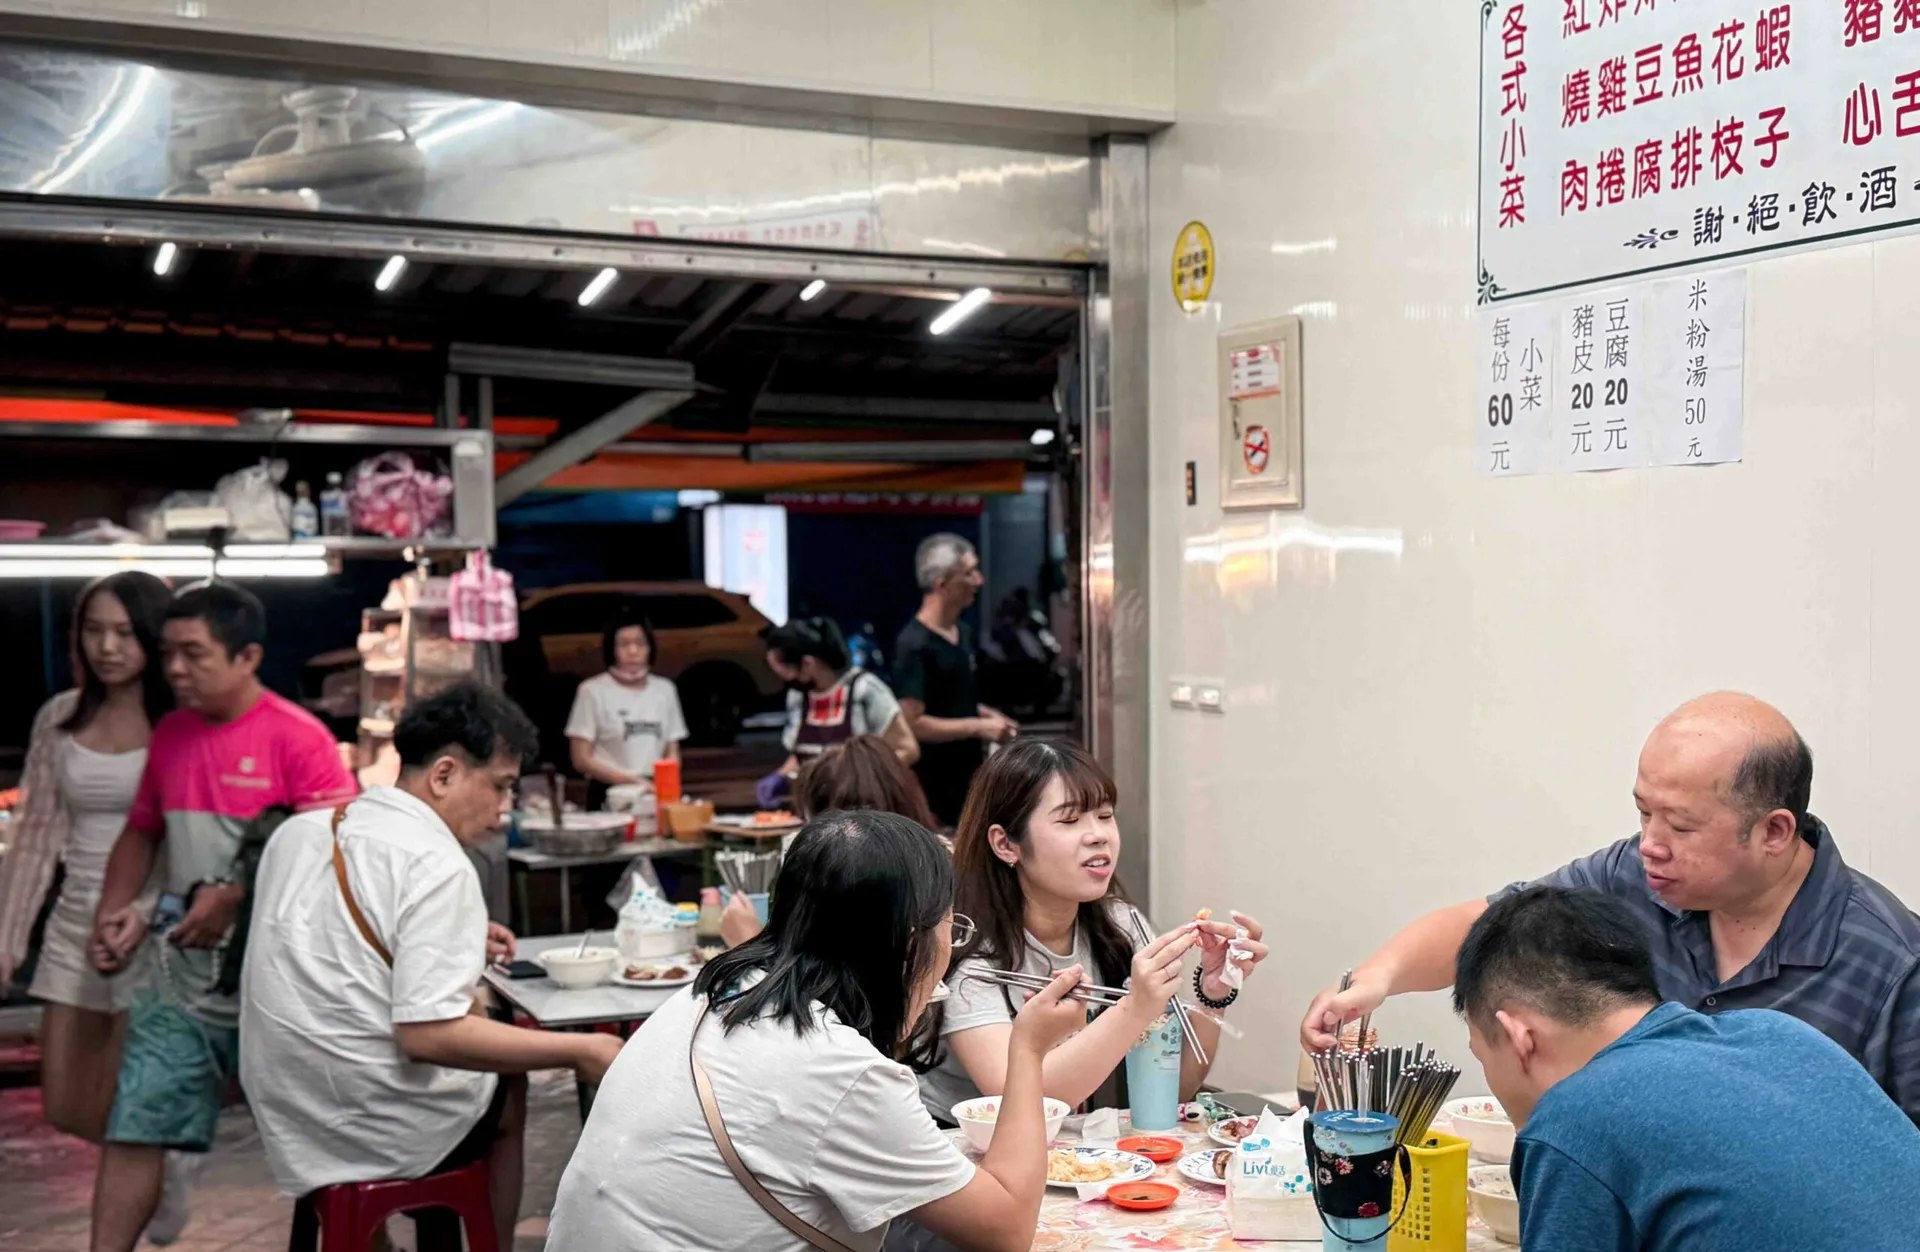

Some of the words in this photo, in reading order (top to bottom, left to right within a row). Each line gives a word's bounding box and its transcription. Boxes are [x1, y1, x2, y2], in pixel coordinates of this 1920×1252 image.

[1499, 3, 1528, 228] 各式小菜
[1633, 0, 1664, 199] 豆腐
[1519, 337, 1543, 411] 小菜
